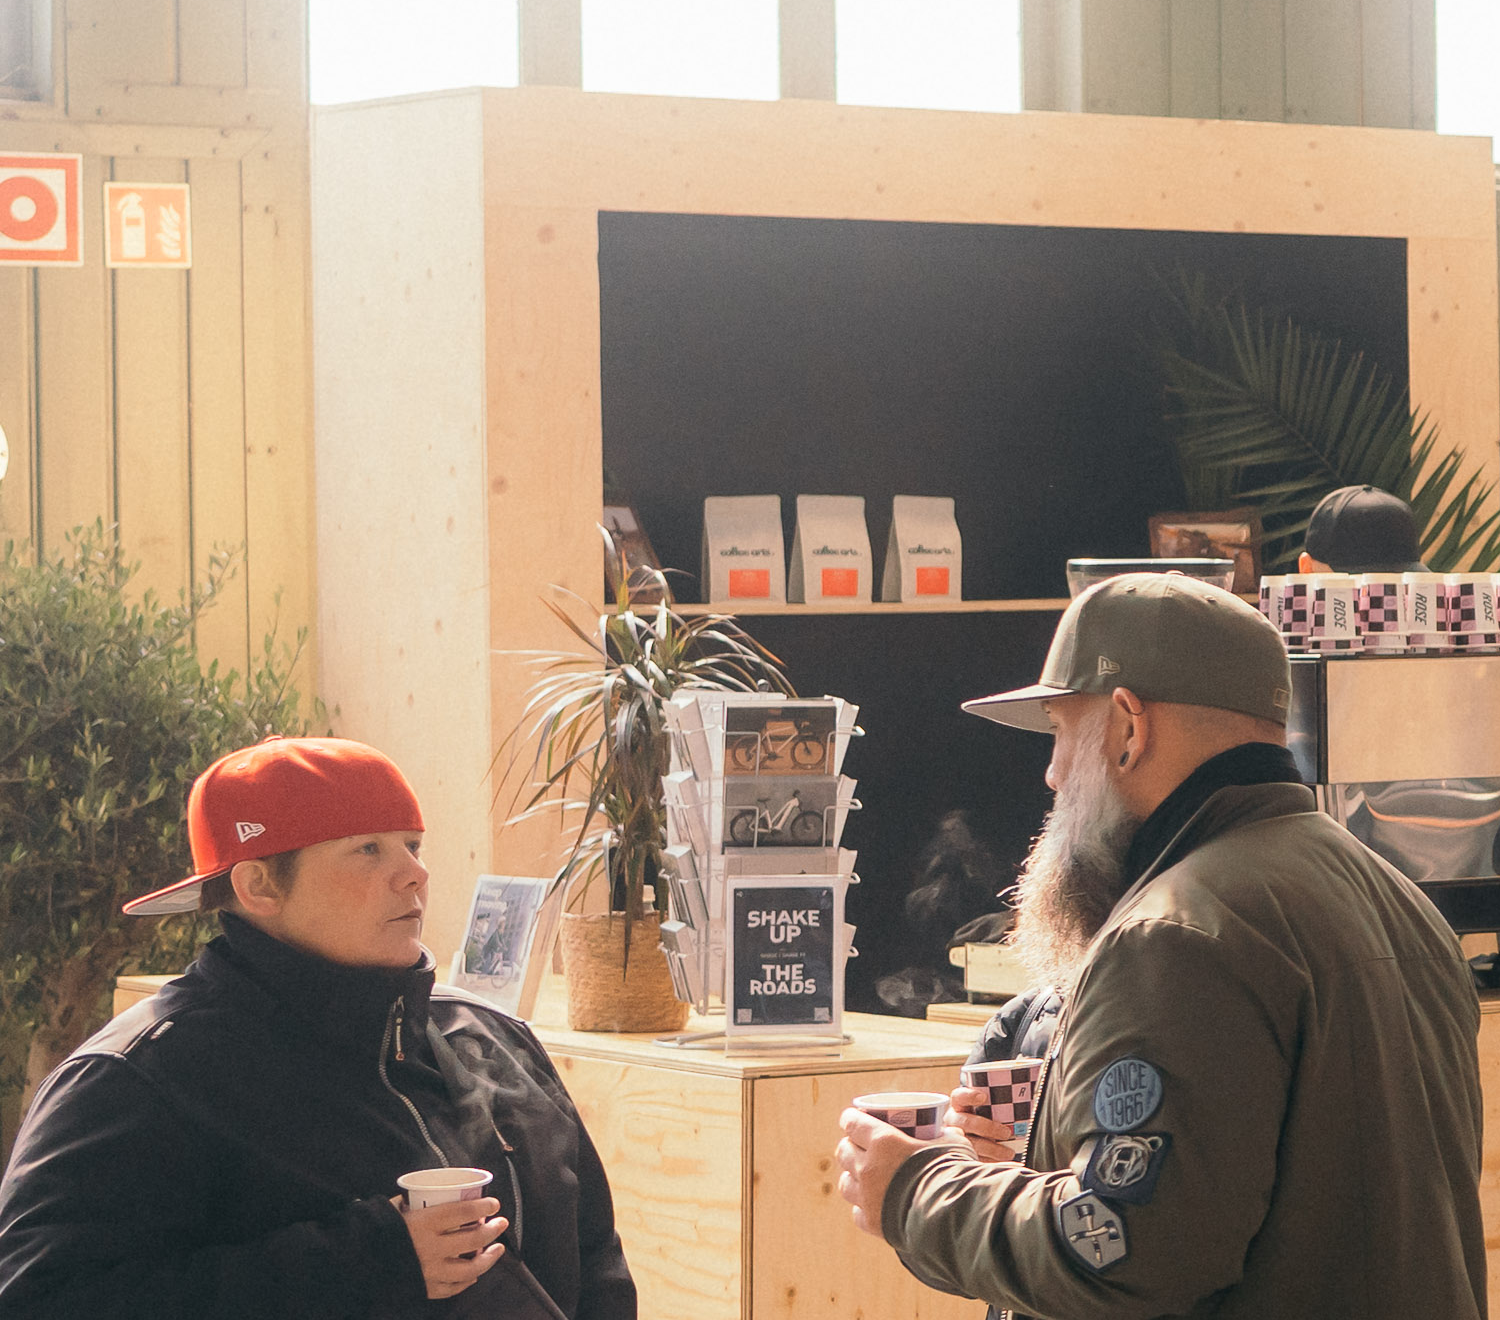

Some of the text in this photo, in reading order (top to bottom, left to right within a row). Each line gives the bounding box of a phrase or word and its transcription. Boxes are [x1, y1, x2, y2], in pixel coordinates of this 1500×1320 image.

[1333, 597, 1347, 631] ROSE
[1415, 592, 1428, 625] ROSE
[1482, 592, 1495, 624] ROSE
[747, 910, 820, 927] SHAKE
[769, 925, 801, 943] UP
[750, 979, 816, 995] ROADS
[762, 964, 804, 981] THE
[1105, 1062, 1147, 1098] SINCE
[1108, 1092, 1144, 1127] 1966
